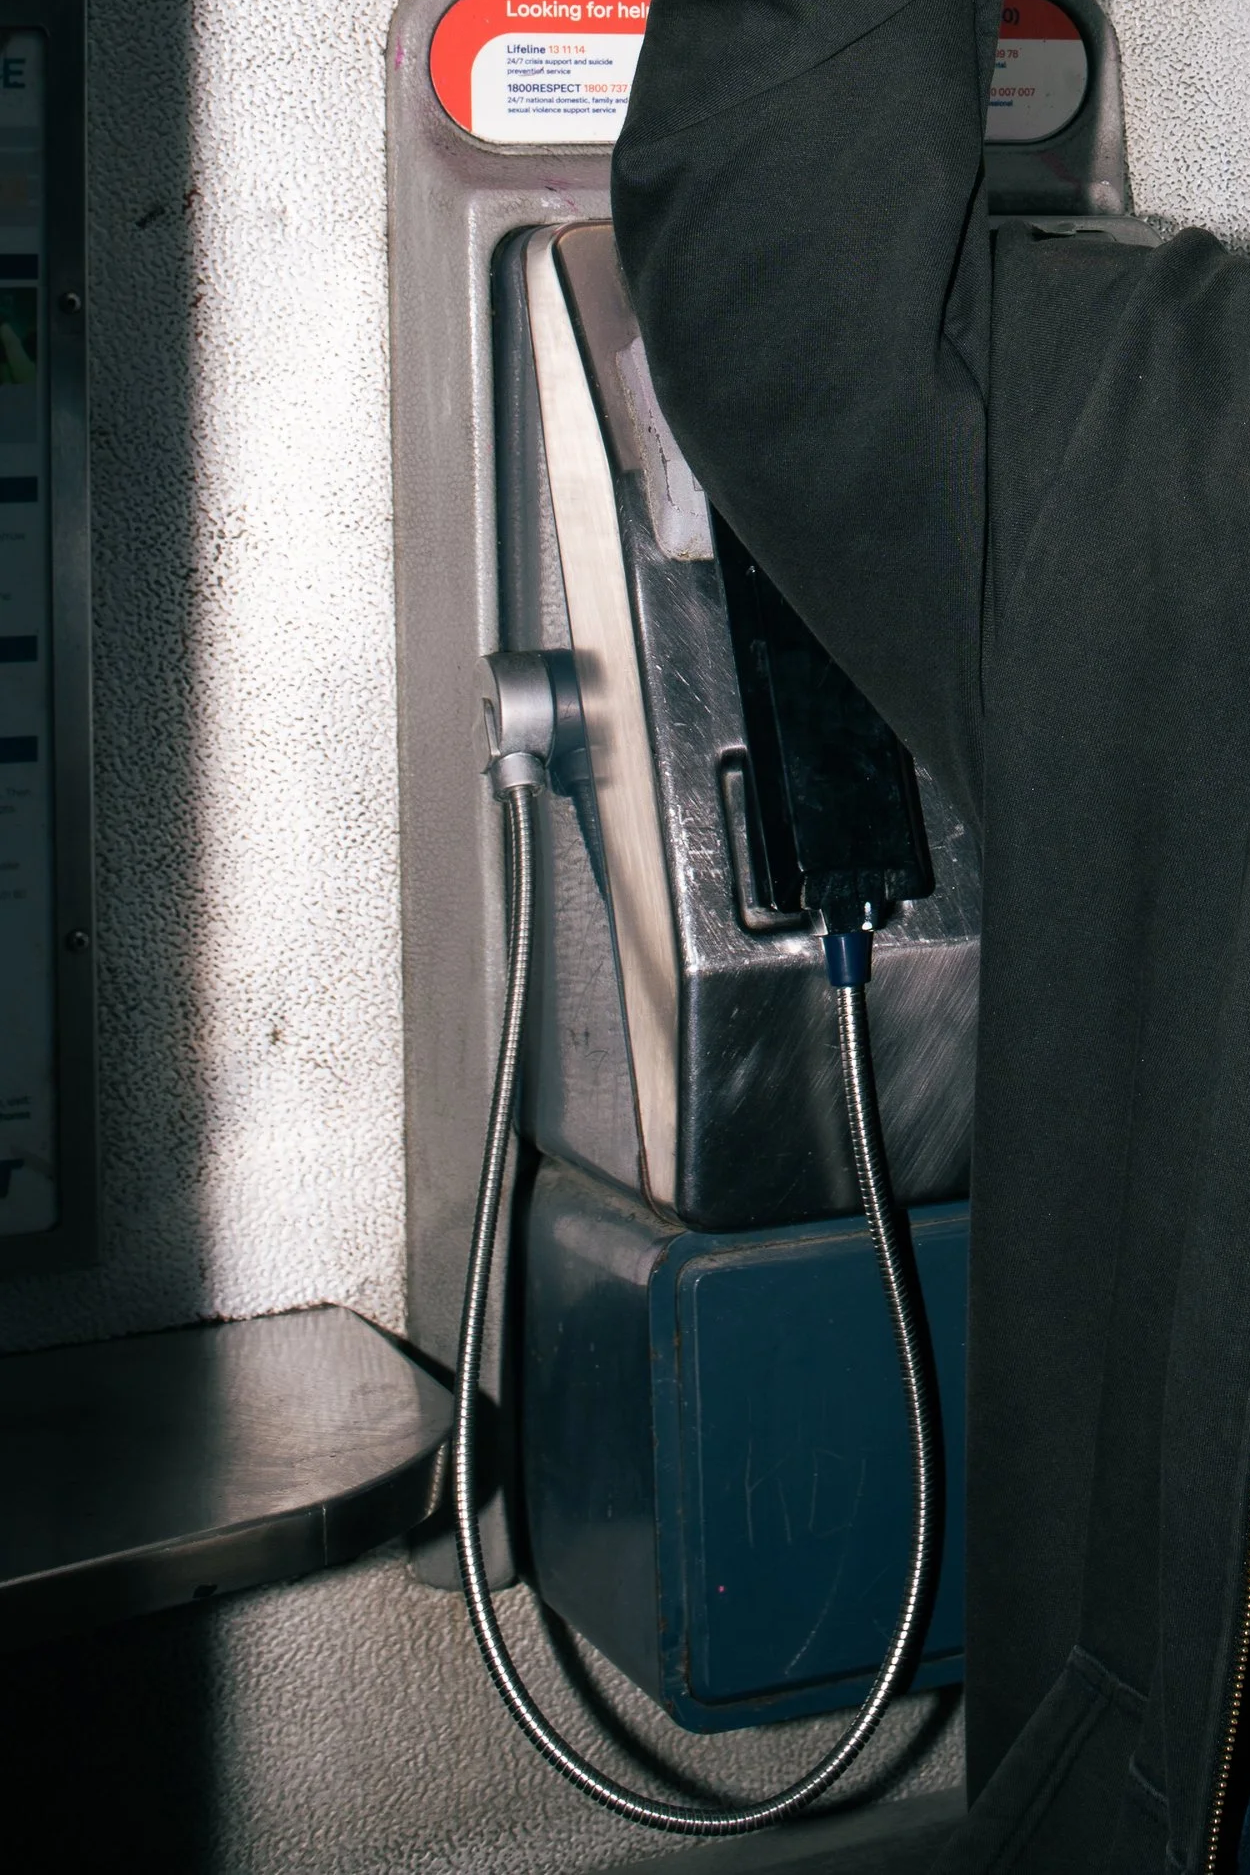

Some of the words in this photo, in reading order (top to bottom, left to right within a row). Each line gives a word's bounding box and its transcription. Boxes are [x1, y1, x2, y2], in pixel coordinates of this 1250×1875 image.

[505, 0, 582, 22] Looking
[586, 0, 614, 18] for
[617, 1, 650, 19] hel
[507, 44, 546, 54] Lifeline
[548, 45, 560, 54] 13
[562, 45, 571, 54] 11
[574, 45, 586, 54] 14
[507, 57, 524, 65] 24/7
[525, 57, 543, 65] crisis
[545, 57, 572, 67] support
[573, 57, 587, 65] and
[588, 57, 613, 65] suicide
[507, 67, 545, 76] prevention
[546, 67, 571, 75] service
[507, 84, 582, 93] 1800RESPECT
[584, 84, 608, 93] 1800
[611, 84, 628, 93] 737
[998, 88, 1015, 97] 007
[1018, 88, 1036, 97] 007
[507, 96, 524, 104] 24/7
[525, 96, 554, 104] national
[556, 96, 591, 105] domestic,
[592, 96, 613, 106] family
[615, 96, 628, 104] and
[507, 106, 531, 114] sexual
[532, 106, 561, 114] violence
[563, 106, 590, 116] support
[592, 106, 616, 114] service
